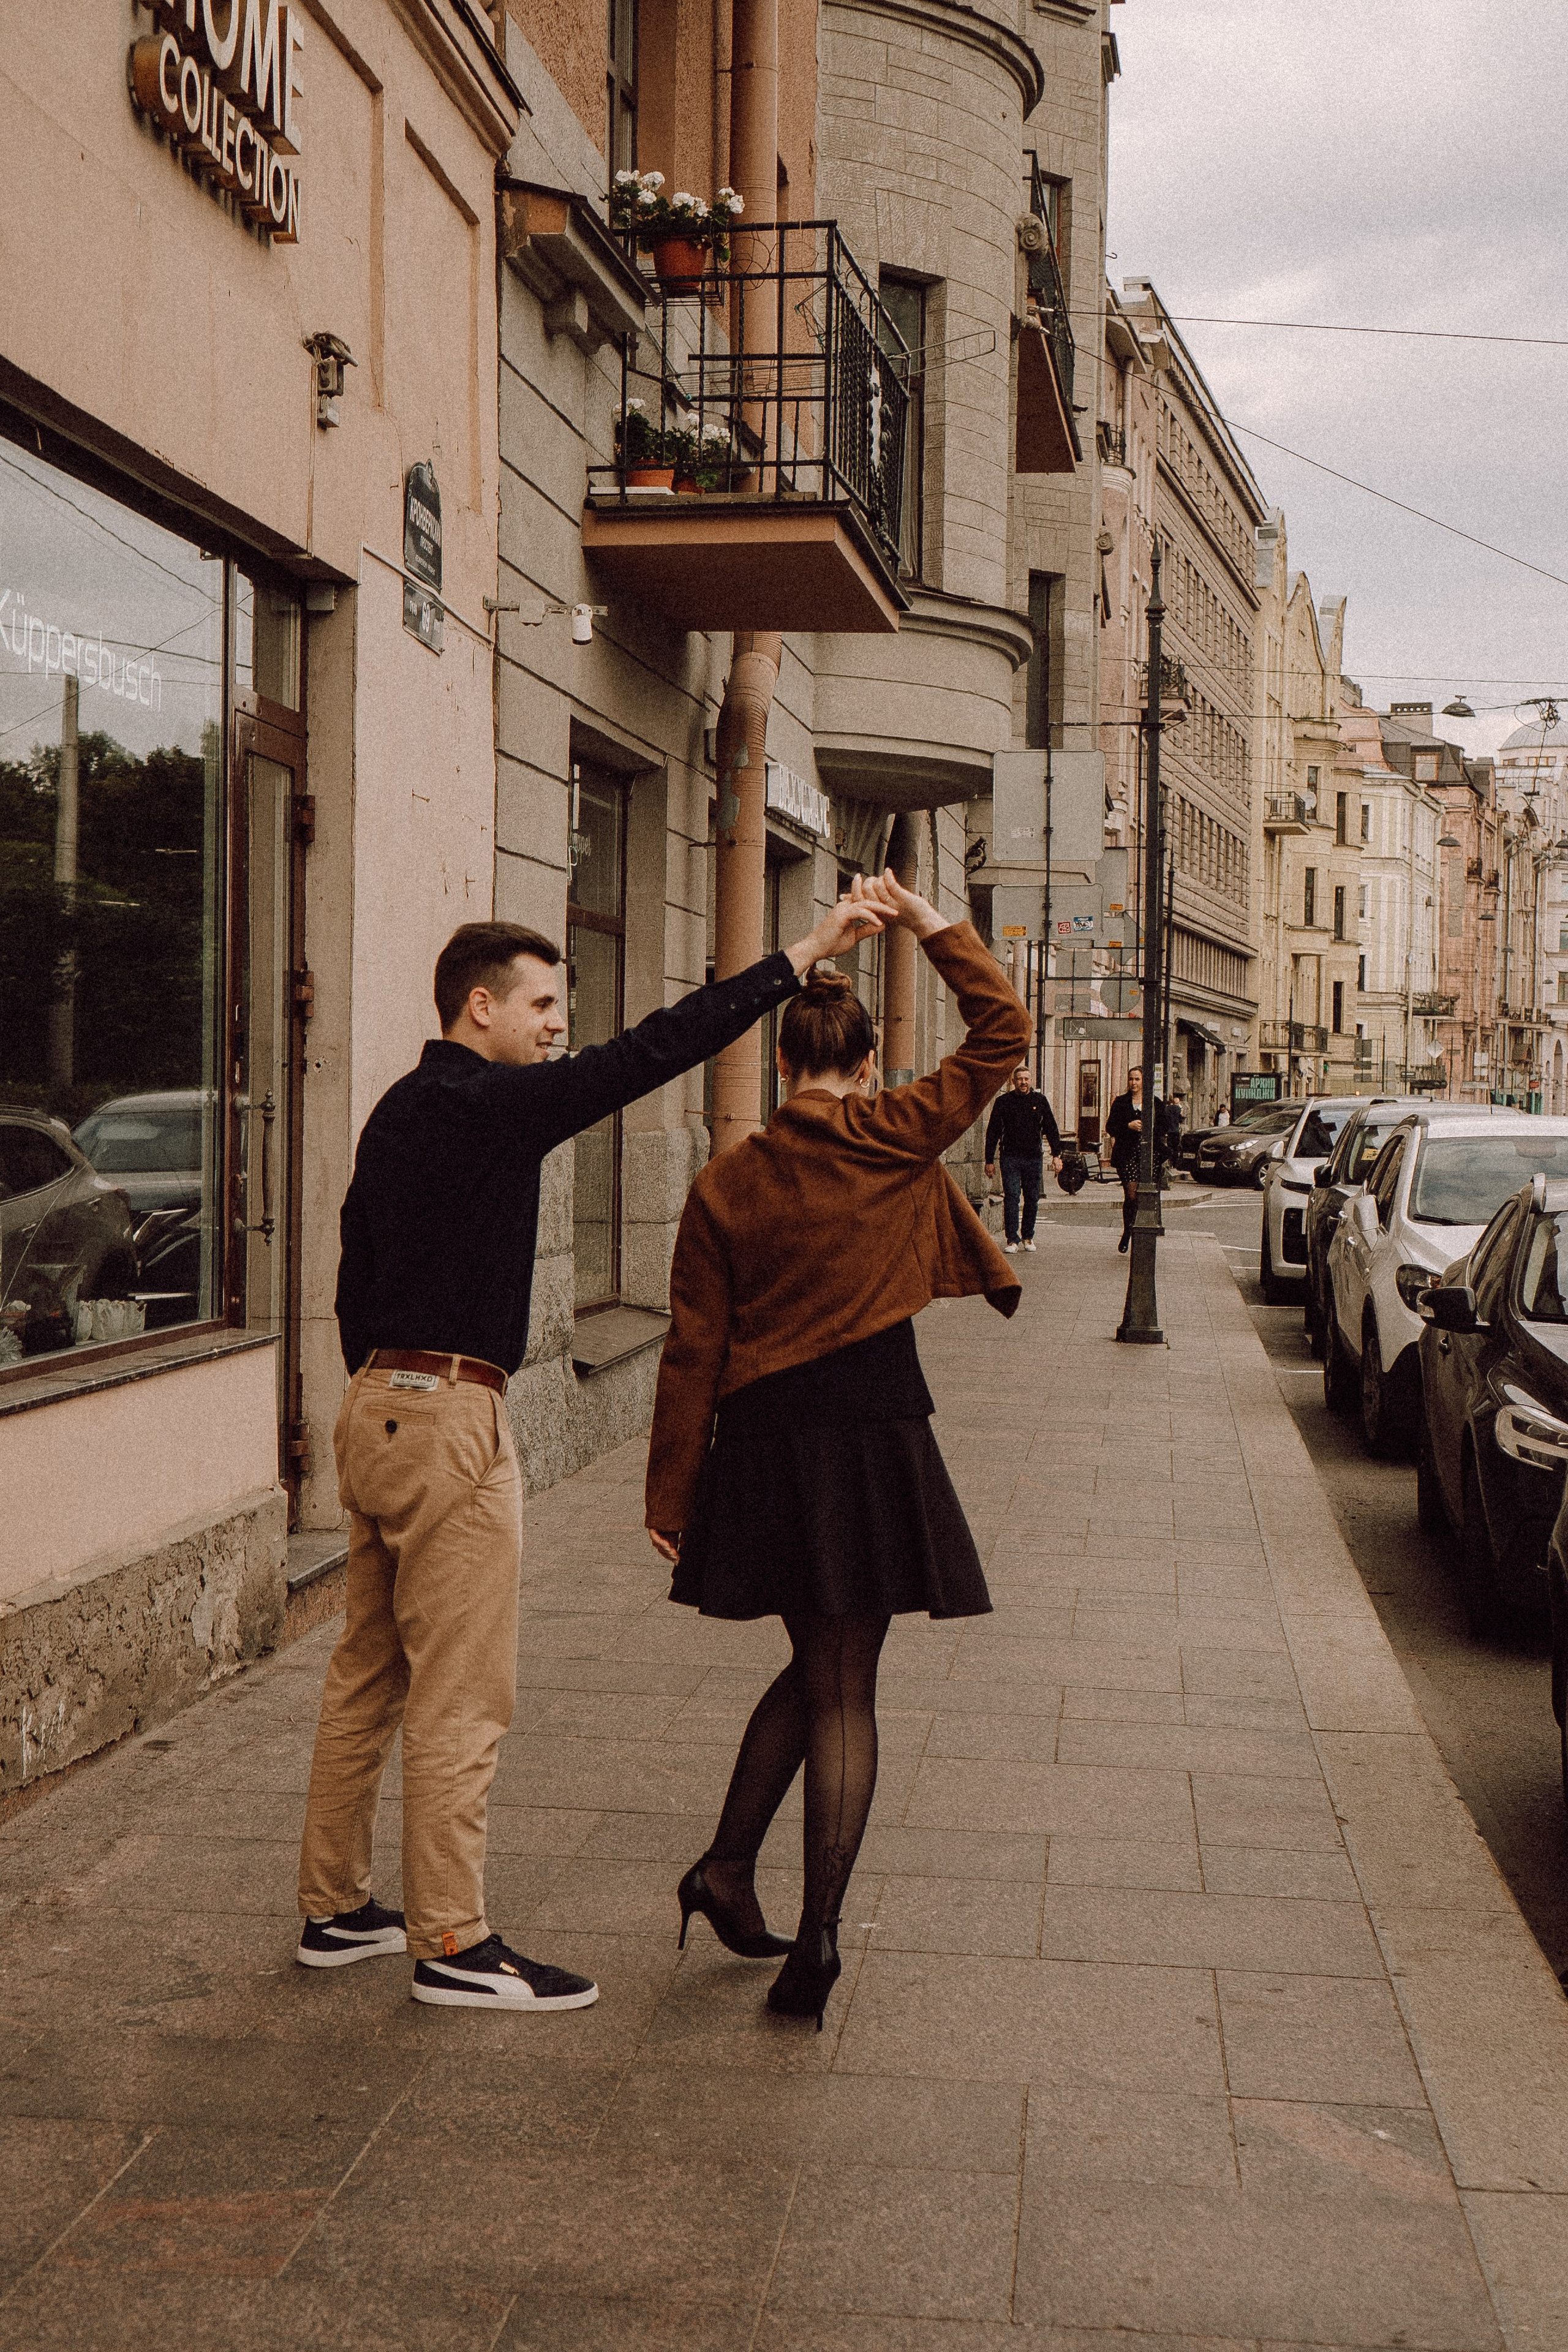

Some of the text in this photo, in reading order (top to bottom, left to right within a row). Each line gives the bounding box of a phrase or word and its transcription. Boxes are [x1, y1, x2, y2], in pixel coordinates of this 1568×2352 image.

[159, 33, 301, 244] COLLECTION
[0, 588, 161, 712] Küppersbusch
[1250, 1077, 1275, 1088] АРХИП
